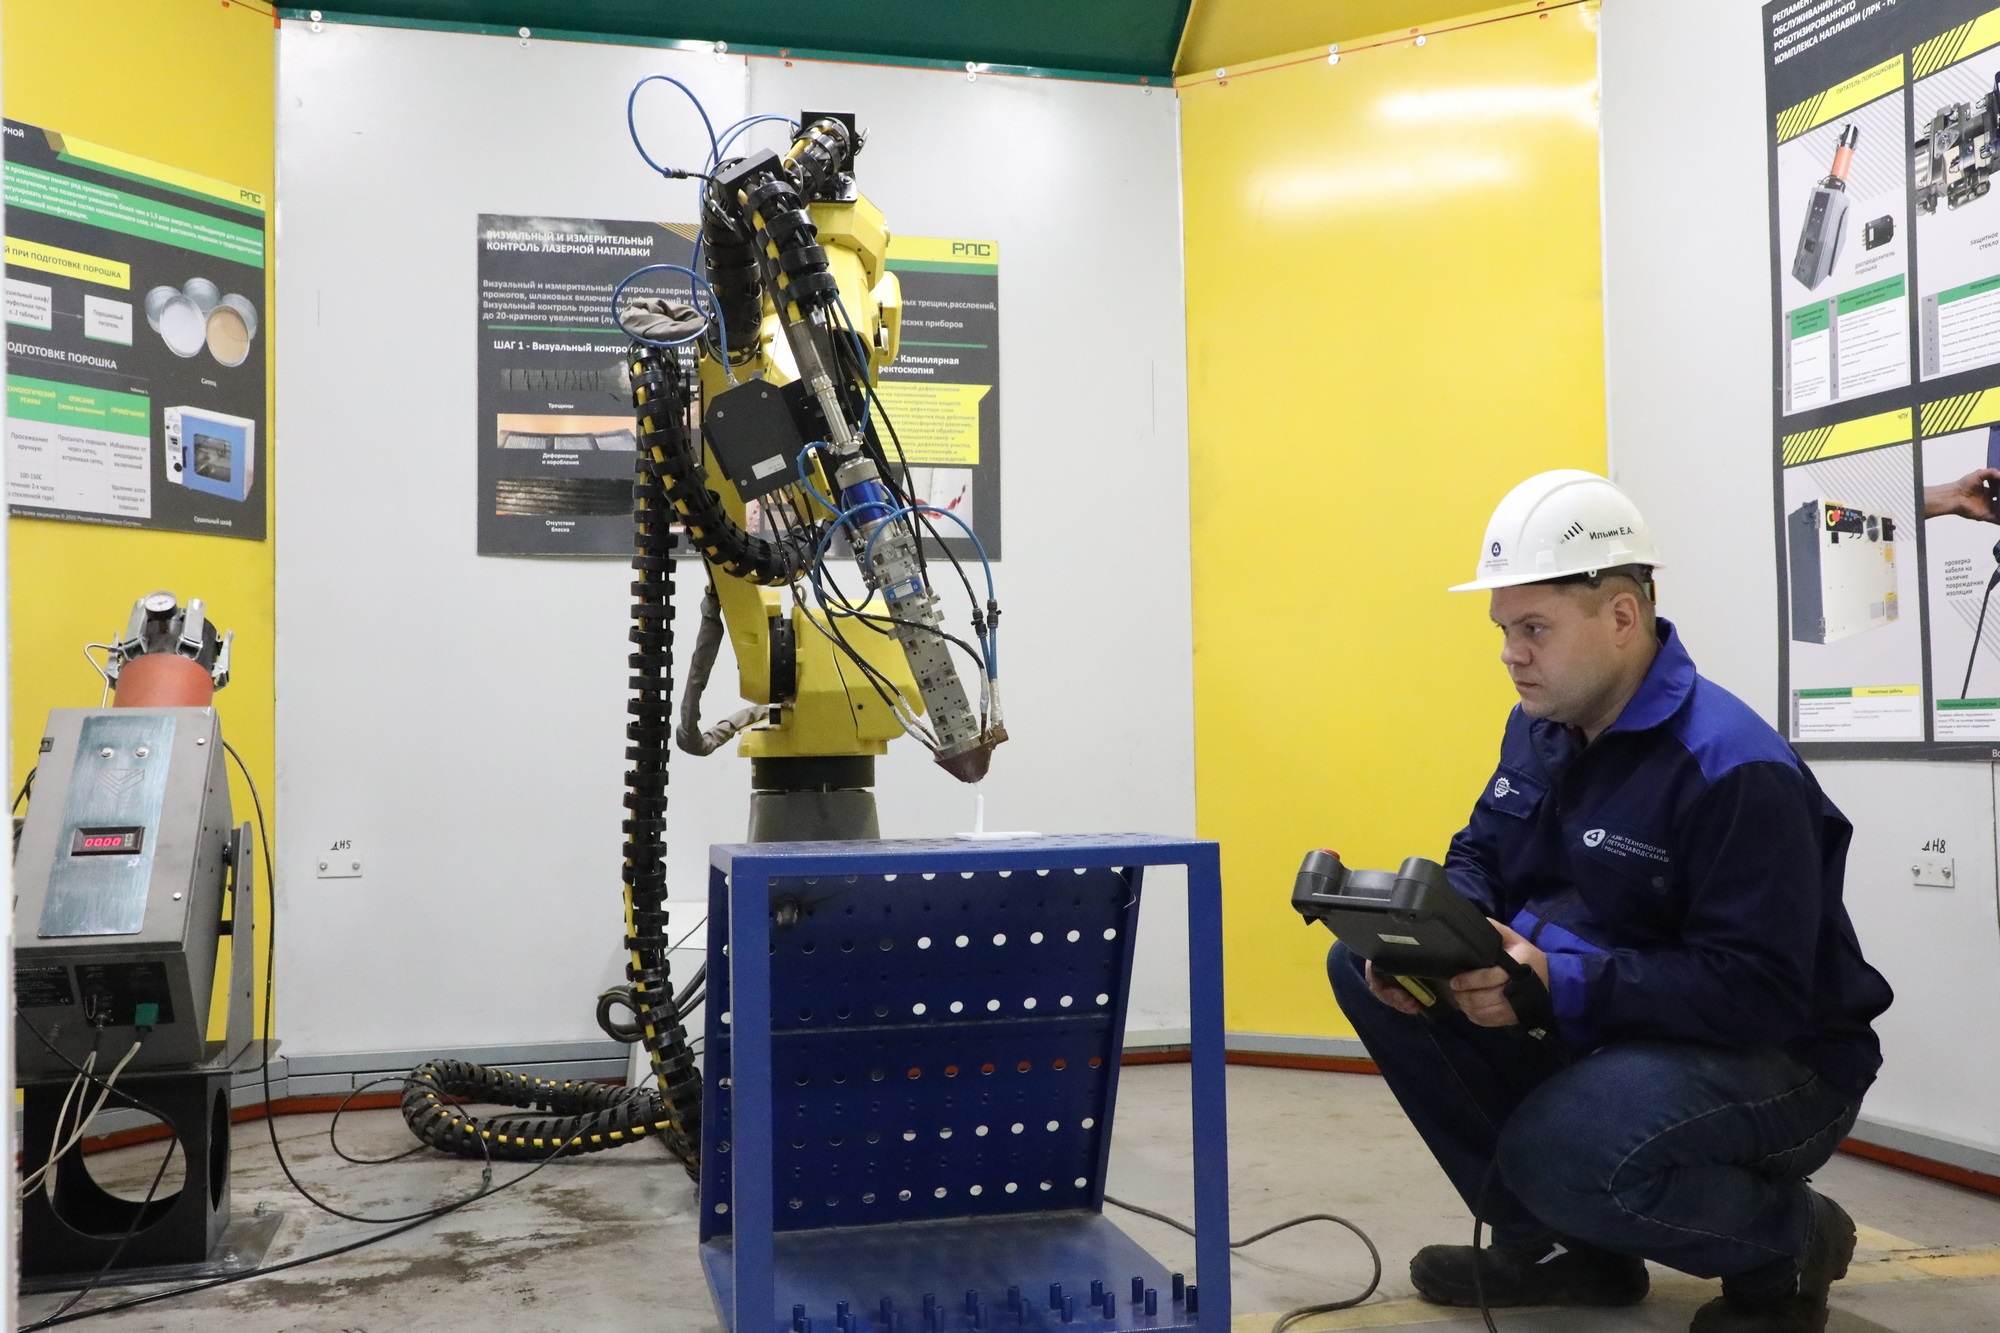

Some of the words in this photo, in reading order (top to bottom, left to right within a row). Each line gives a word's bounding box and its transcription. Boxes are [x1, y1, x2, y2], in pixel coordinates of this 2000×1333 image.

[1774, 1, 1856, 51] РОБОТИЗИРОВАННОГО
[1774, 36, 1818, 65] КОМПЛЕКСА
[1820, 12, 1861, 42] НАПЛАВКИ
[1862, 1, 1881, 21] (ЛРК
[1836, 78, 1861, 95] ПИТАТЕЛЬ
[1862, 59, 1900, 83] ПОРОШКОВЫЙ
[486, 230, 553, 242] ВИЗУАЛЬНЫЙ
[557, 234, 564, 242] И
[566, 232, 654, 246] ИЗМЕРИТЕЛЬНЫЙ
[1970, 232, 1999, 246] защитное
[486, 242, 540, 253] КОНТРОЛЬ
[542, 243, 594, 255] ЛАЗЕРНОЙ
[597, 246, 650, 257] НАПЛАВКИ
[1979, 240, 1999, 250] стекло
[12, 249, 29, 258] ПРИ
[31, 252, 81, 270] ПОДГОТОВКЕ
[83, 264, 122, 279] ПОРОШКА
[1854, 251, 1895, 269] распределитель
[1855, 265, 1878, 276] порошка
[483, 279, 535, 289] Визуальный
[545, 284, 613, 293] измерительный
[483, 292, 527, 300] прожогов,
[529, 293, 573, 301] шлаковых
[483, 301, 535, 310] Визуальный
[538, 304, 577, 312] контроль
[93, 309, 124, 320] Порошковый
[496, 312, 547, 321] 20-кратного
[549, 315, 599, 323] увеличения
[925, 320, 964, 328] приборов
[494, 341, 516, 350] ШАГ
[518, 342, 524, 350] 1
[532, 342, 592, 353] Визуальный
[68, 353, 117, 370] ПОРОШКА
[901, 355, 959, 366] Капиллярная
[548, 402, 574, 410] Трещины
[1898, 412, 1908, 420] ЧПУ
[1590, 530, 1619, 540] Ильин
[1620, 527, 1634, 536] Е.А.
[1944, 558, 1971, 567] проверка
[1945, 566, 1964, 574] кабеля
[1945, 574, 1968, 582] наличие
[1945, 581, 1984, 590] повреждения
[1946, 589, 1973, 597] изоляции
[1605, 846, 1627, 857] РОСАТОМ
[1607, 839, 1670, 863] ПЕТРОЗАВОДСКМАШ
